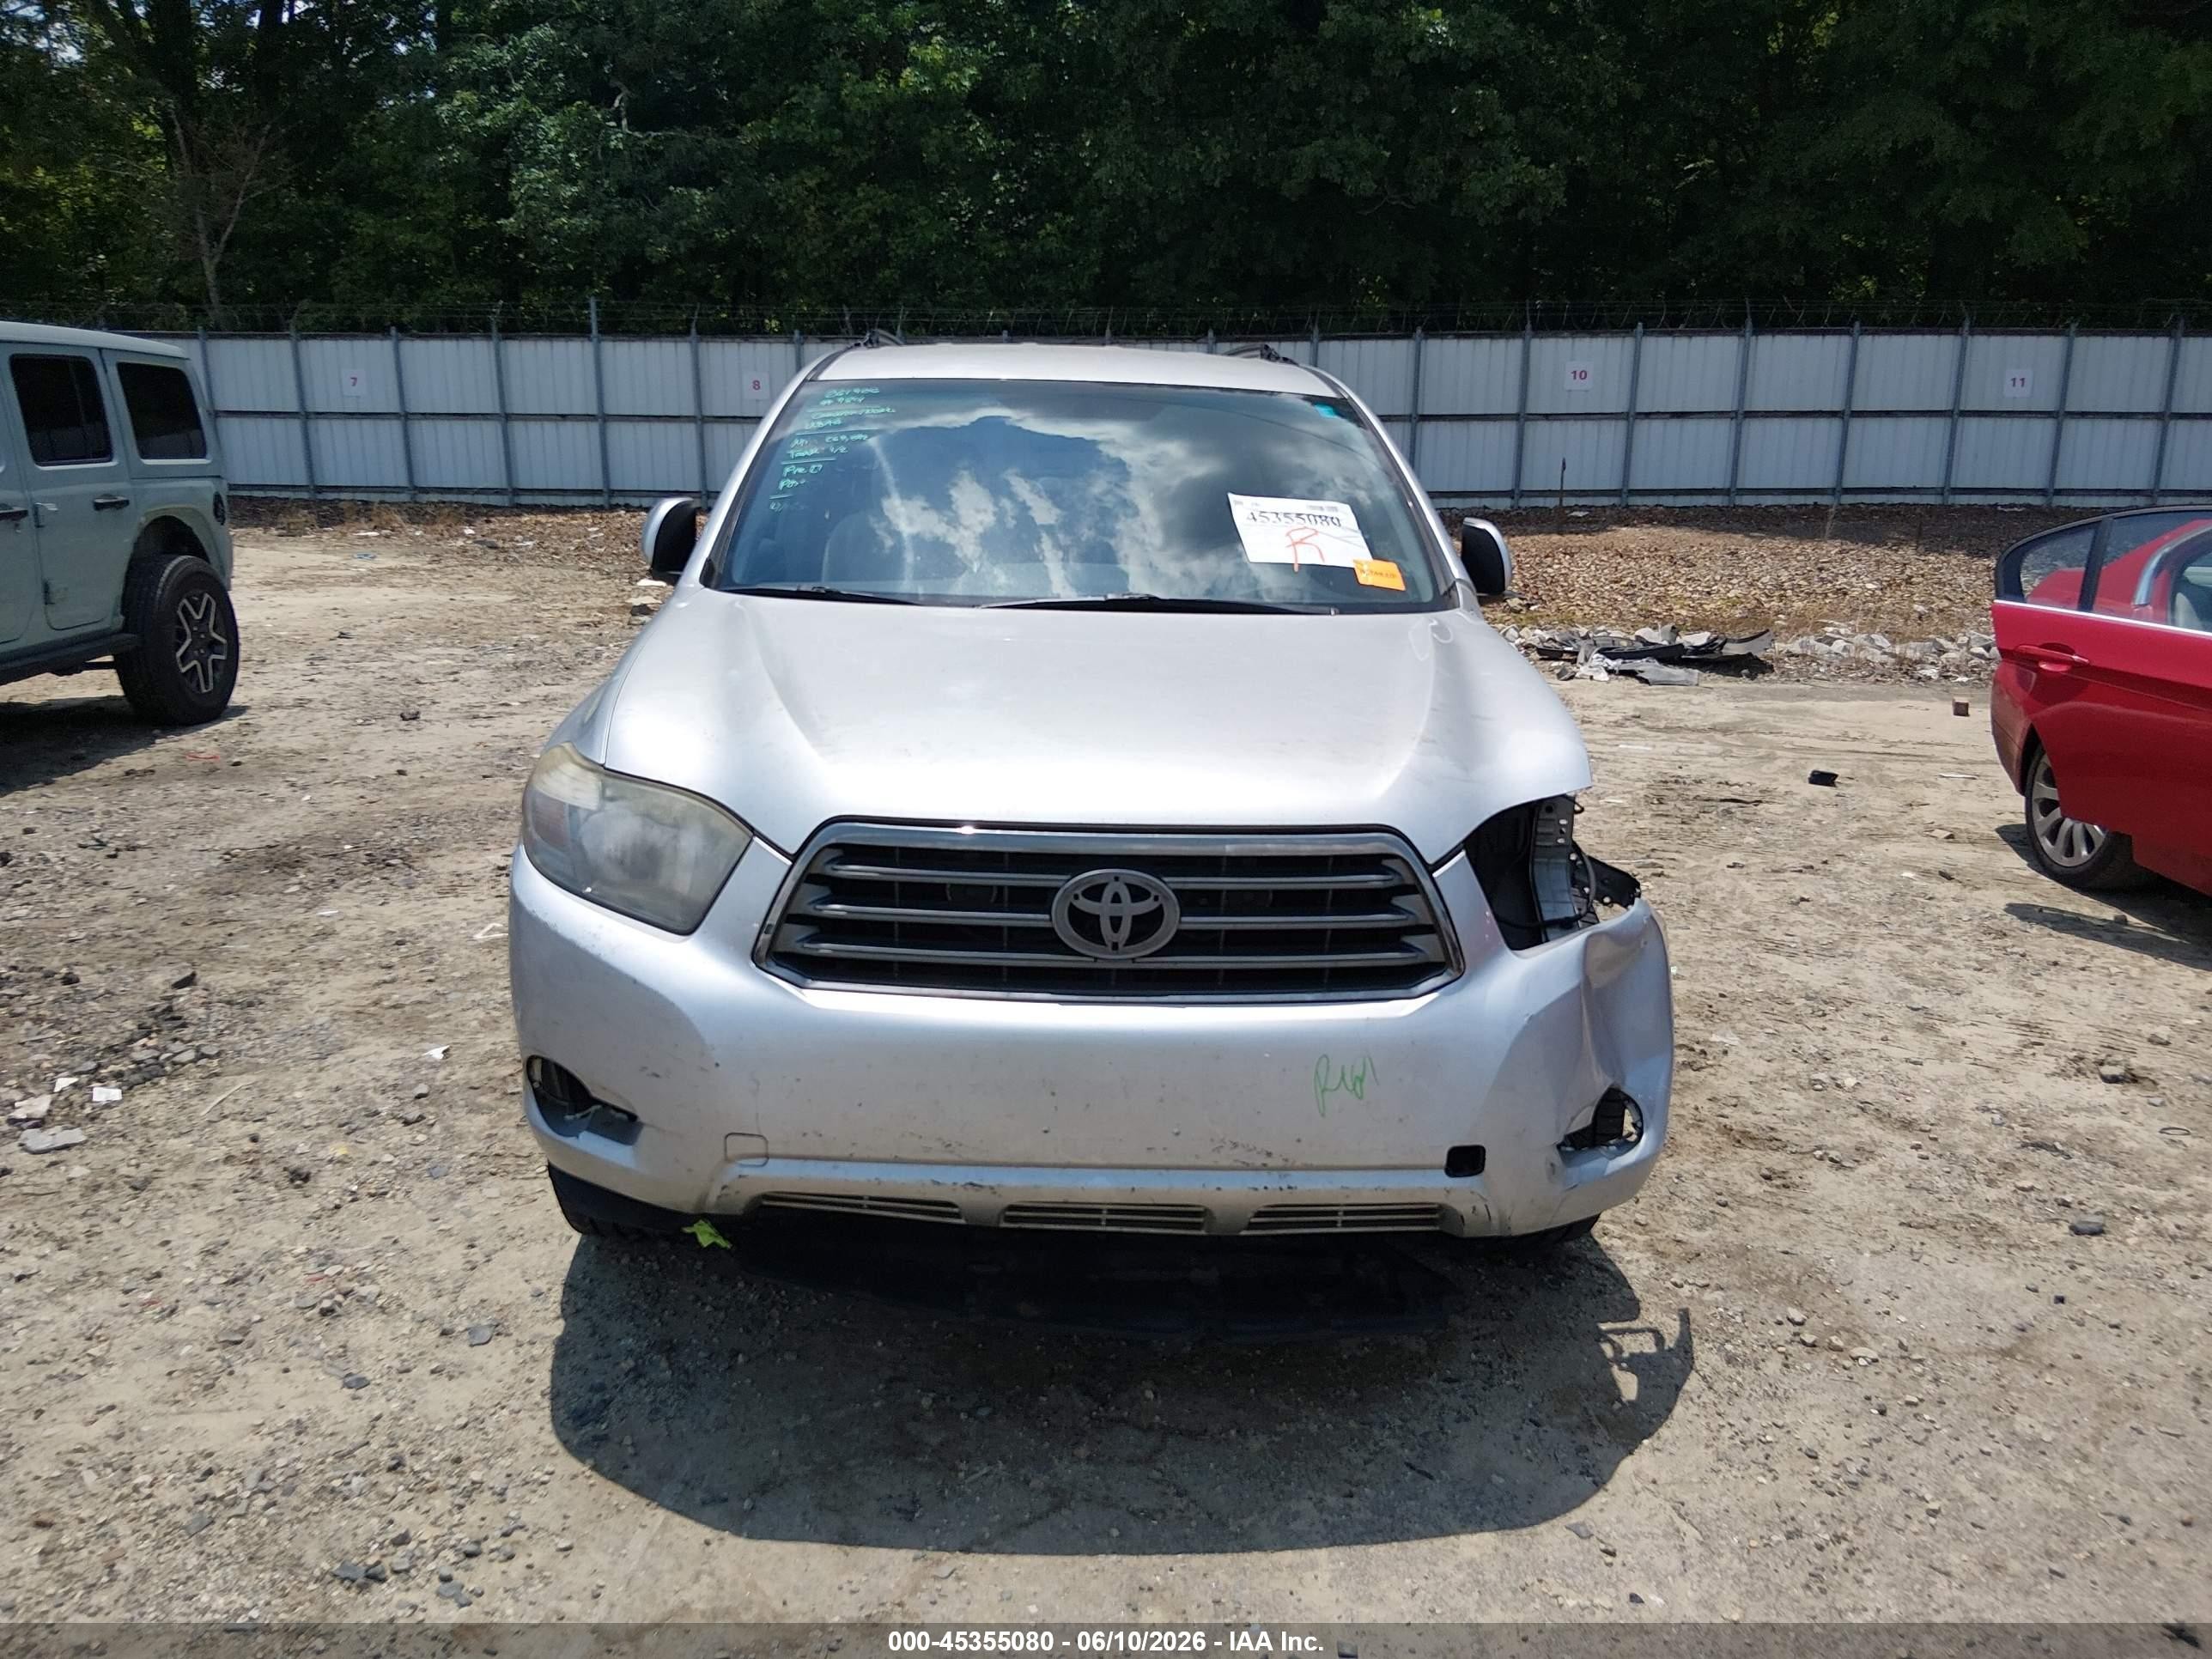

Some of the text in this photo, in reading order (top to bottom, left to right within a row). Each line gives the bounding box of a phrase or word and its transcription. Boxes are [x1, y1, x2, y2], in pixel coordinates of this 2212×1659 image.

[1571, 370, 1587, 380] 10
[350, 376, 358, 386] 7
[752, 380, 761, 391] 8
[2010, 377, 2025, 387] 11
[1246, 511, 1341, 527] 45355080
